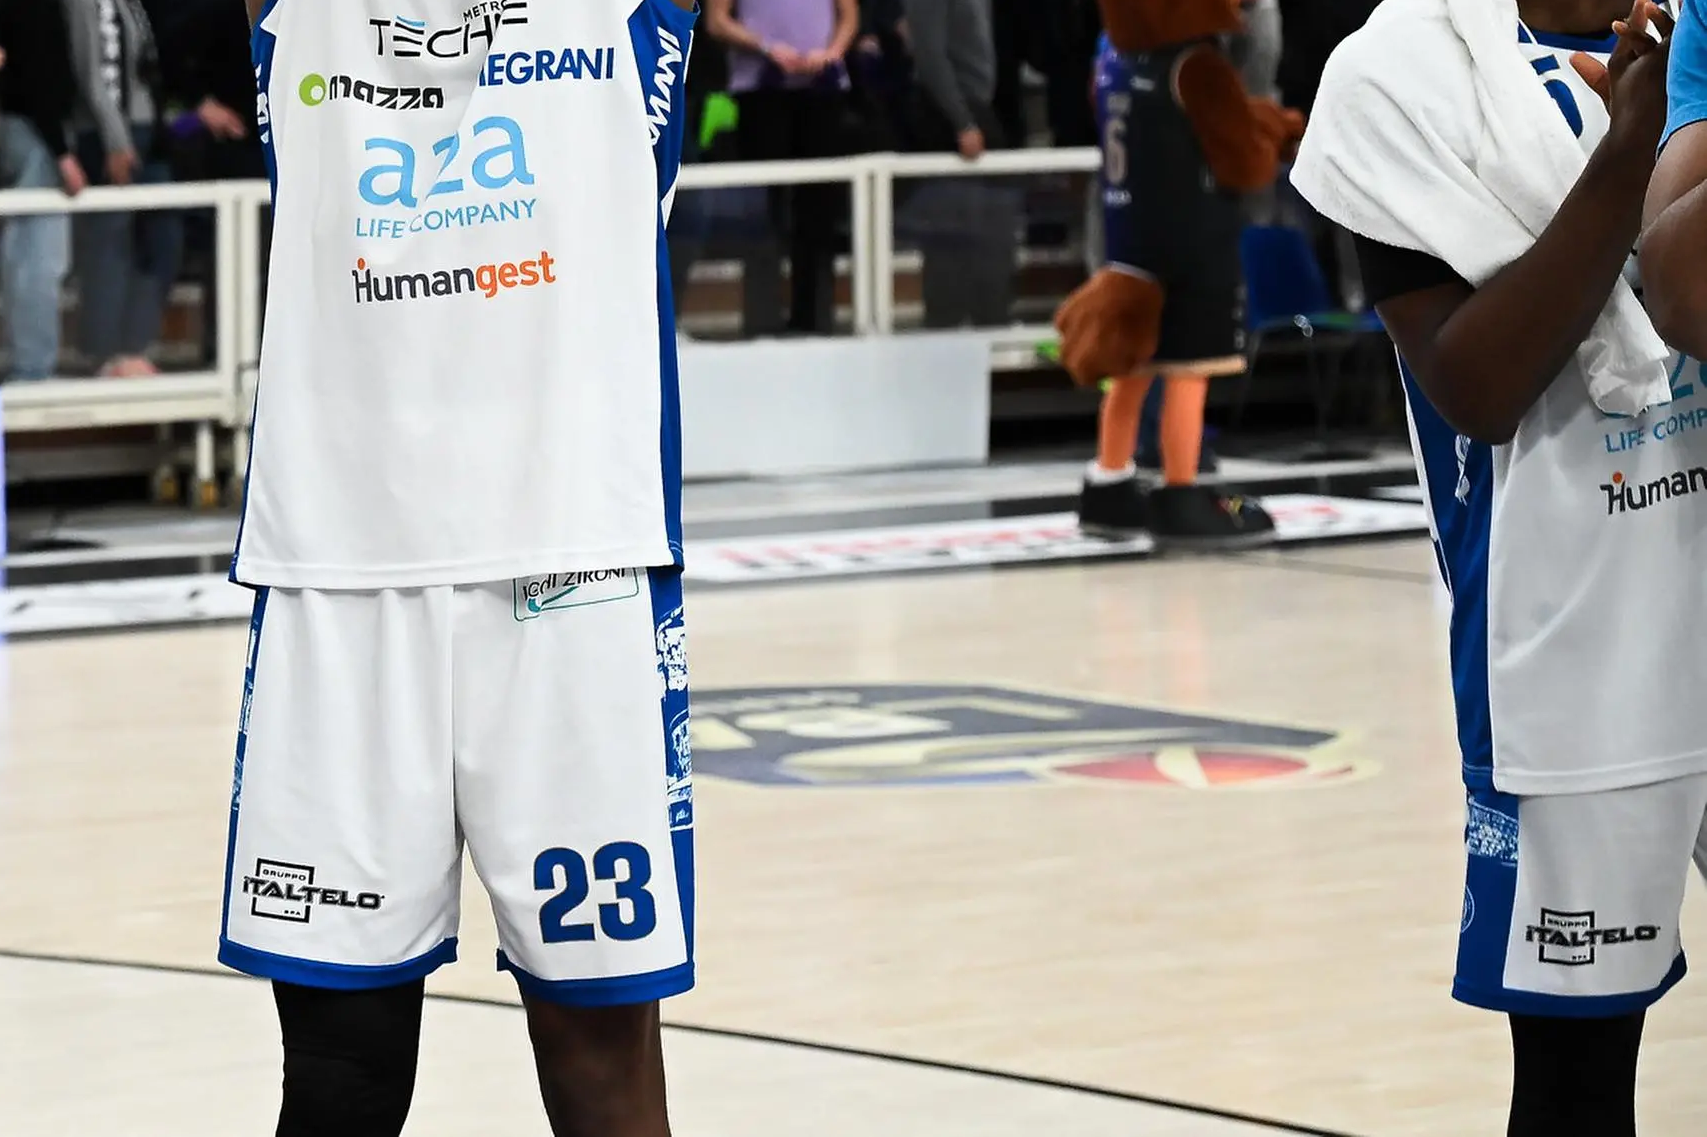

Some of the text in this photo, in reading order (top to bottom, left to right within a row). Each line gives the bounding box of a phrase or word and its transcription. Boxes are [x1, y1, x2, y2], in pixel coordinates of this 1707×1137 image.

[357, 115, 535, 210] a2a
[356, 198, 537, 239] LIFE COMPANY
[352, 250, 557, 303] Humangest
[1604, 426, 1647, 454] LIFE
[243, 875, 382, 910] ITALTELO
[262, 868, 306, 881] GRUPPO
[533, 840, 657, 944] 23
[1525, 924, 1658, 947] ITALTELO
